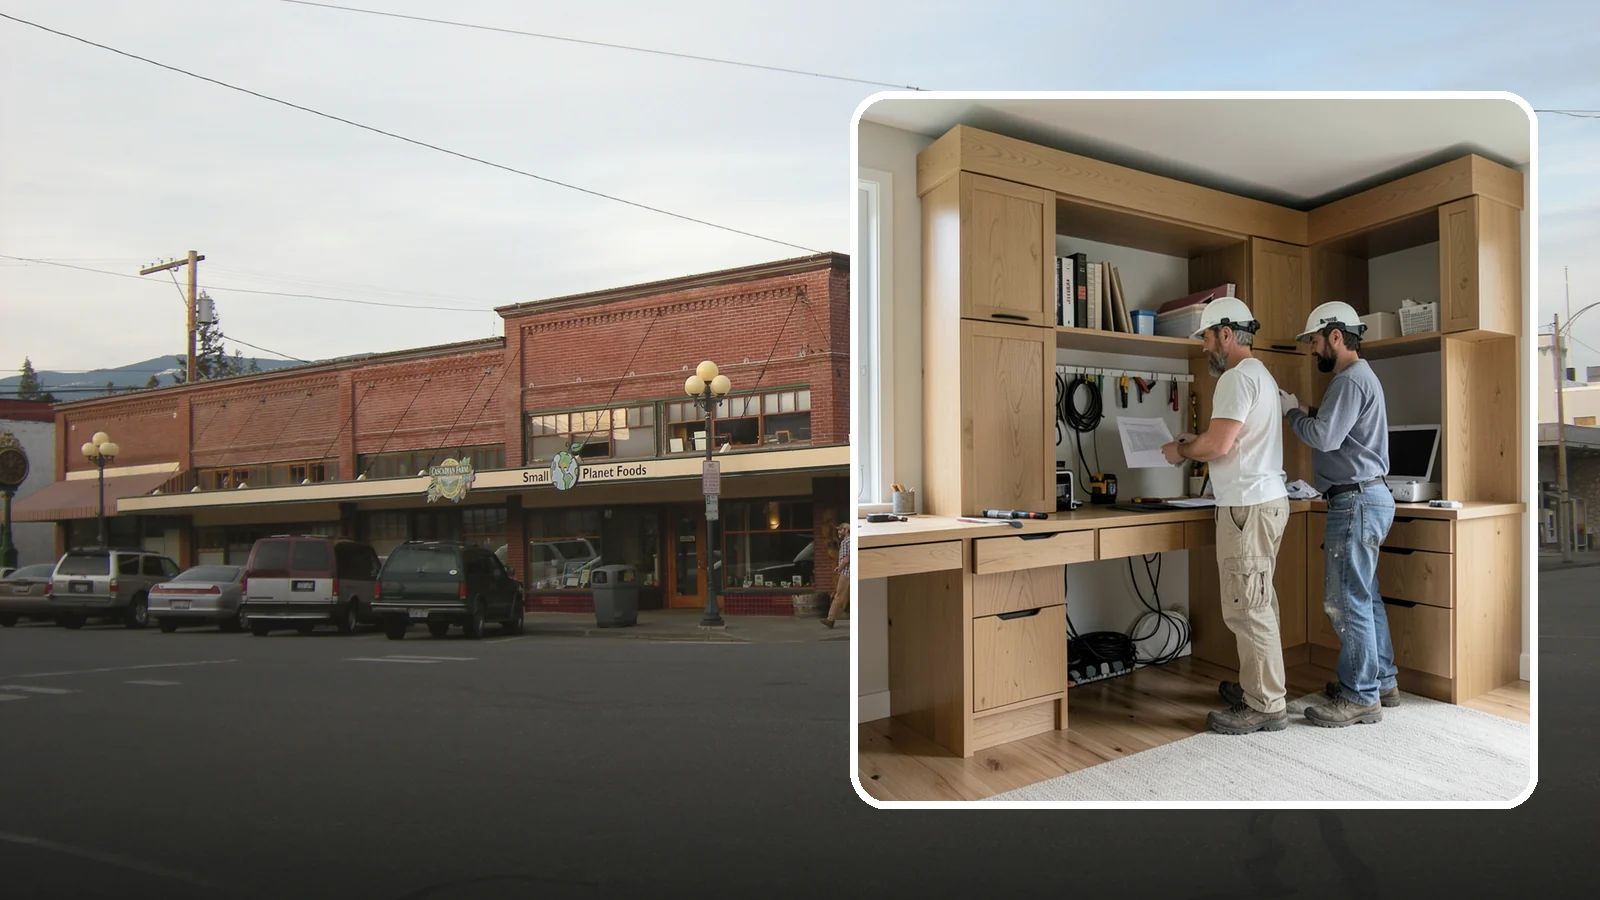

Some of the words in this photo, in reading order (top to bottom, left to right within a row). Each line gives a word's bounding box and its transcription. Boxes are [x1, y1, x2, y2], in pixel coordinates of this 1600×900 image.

[431, 466, 455, 476] CASCADIAN
[523, 471, 549, 483] Small
[583, 467, 614, 479] Planet
[617, 464, 647, 477] Foods
